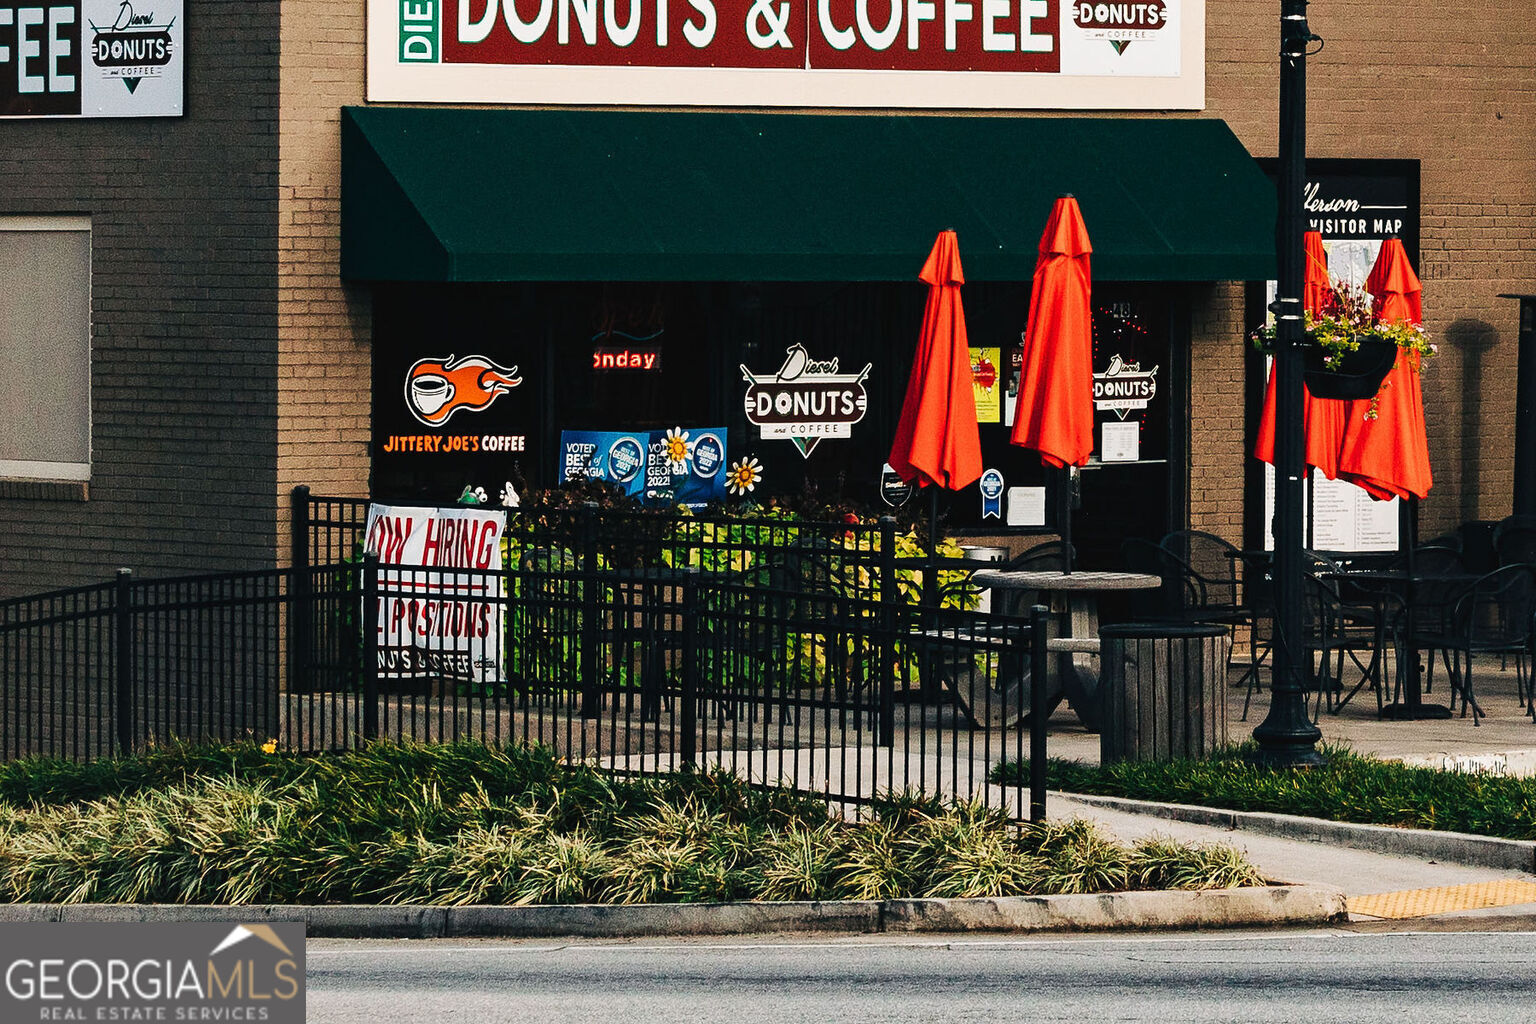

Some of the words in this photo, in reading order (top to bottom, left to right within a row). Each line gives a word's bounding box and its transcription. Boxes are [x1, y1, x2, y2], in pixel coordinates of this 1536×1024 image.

[111, 0, 154, 33] Diesel
[1080, 3, 1159, 25] DONUTS
[1107, 31, 1146, 39] COFFEE
[99, 38, 165, 61] DONUTS
[121, 67, 155, 76] COFFEE
[1309, 219, 1367, 234] VISITOR
[1373, 219, 1403, 234] MAP
[775, 343, 838, 382] Diesel
[1094, 381, 1149, 398] DONUTS
[757, 391, 855, 416] DONUTS
[790, 425, 838, 434] COFFEE
[384, 436, 440, 452] JITTERY
[440, 435, 479, 452] JOE'S
[481, 435, 525, 451] COFFEE
[647, 476, 670, 486] 2022!
[422, 518, 498, 569] HIRING
